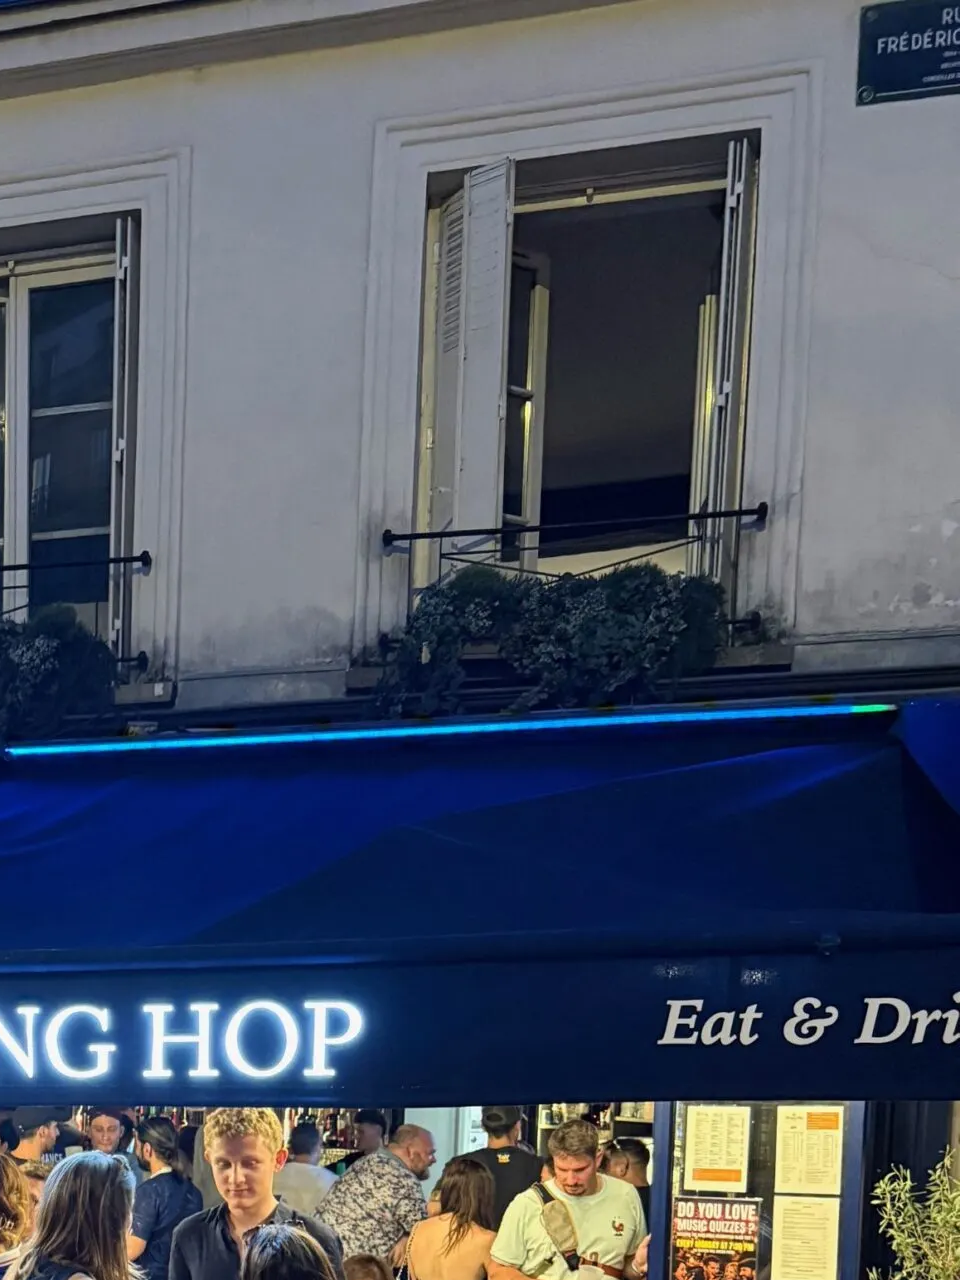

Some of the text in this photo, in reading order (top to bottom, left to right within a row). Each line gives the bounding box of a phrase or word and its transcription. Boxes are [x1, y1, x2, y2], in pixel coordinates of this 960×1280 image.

[657, 999, 763, 1046] Eat
[783, 997, 839, 1046] &
[142, 1000, 363, 1078] HOP
[677, 1201, 756, 1221] DO YOU LOVE
[677, 1218, 708, 1232] MUSIC
[709, 1221, 746, 1234] QUIZZES
